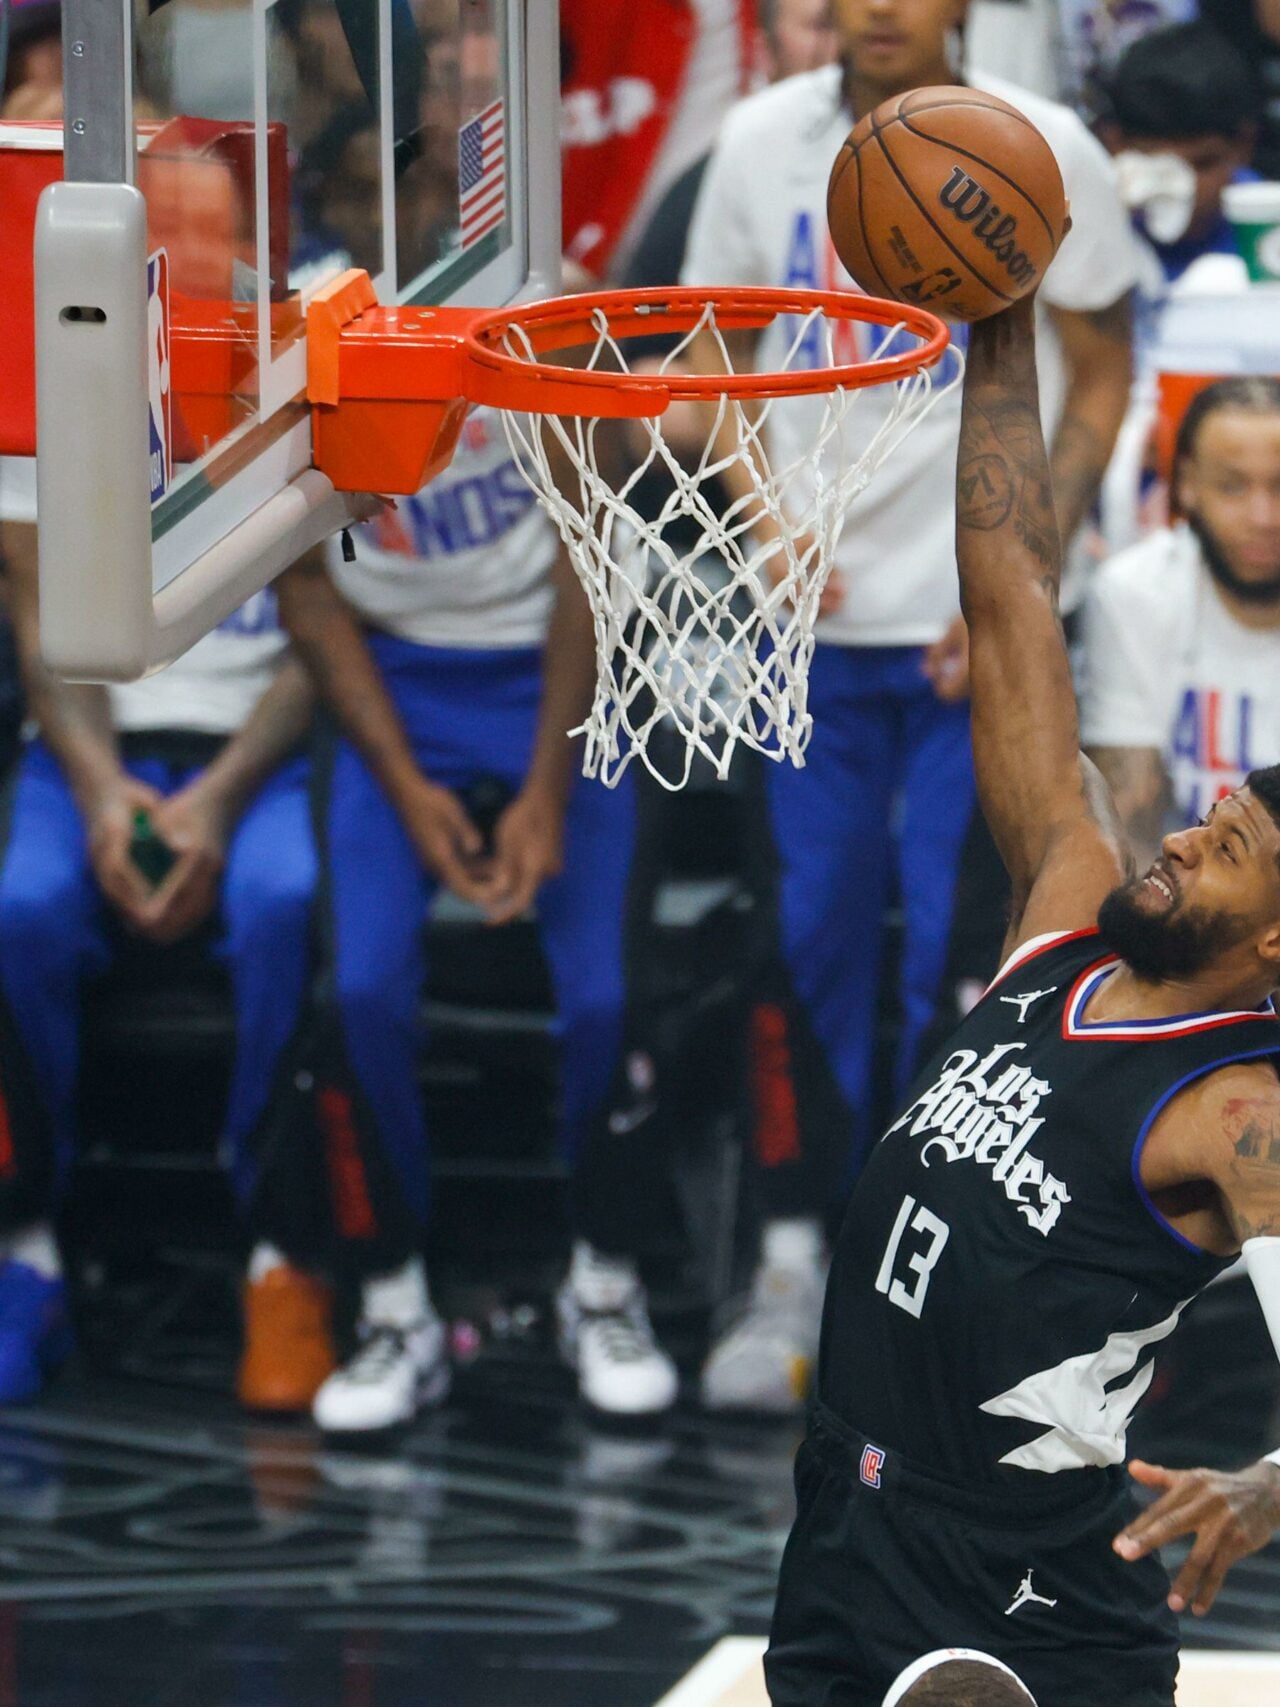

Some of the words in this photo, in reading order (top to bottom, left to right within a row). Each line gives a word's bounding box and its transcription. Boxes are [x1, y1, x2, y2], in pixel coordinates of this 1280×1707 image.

[938, 164, 1037, 288] Wilson
[941, 1042, 1053, 1126] Los
[879, 1067, 1073, 1237] Angeles
[874, 1194, 950, 1320] 13
